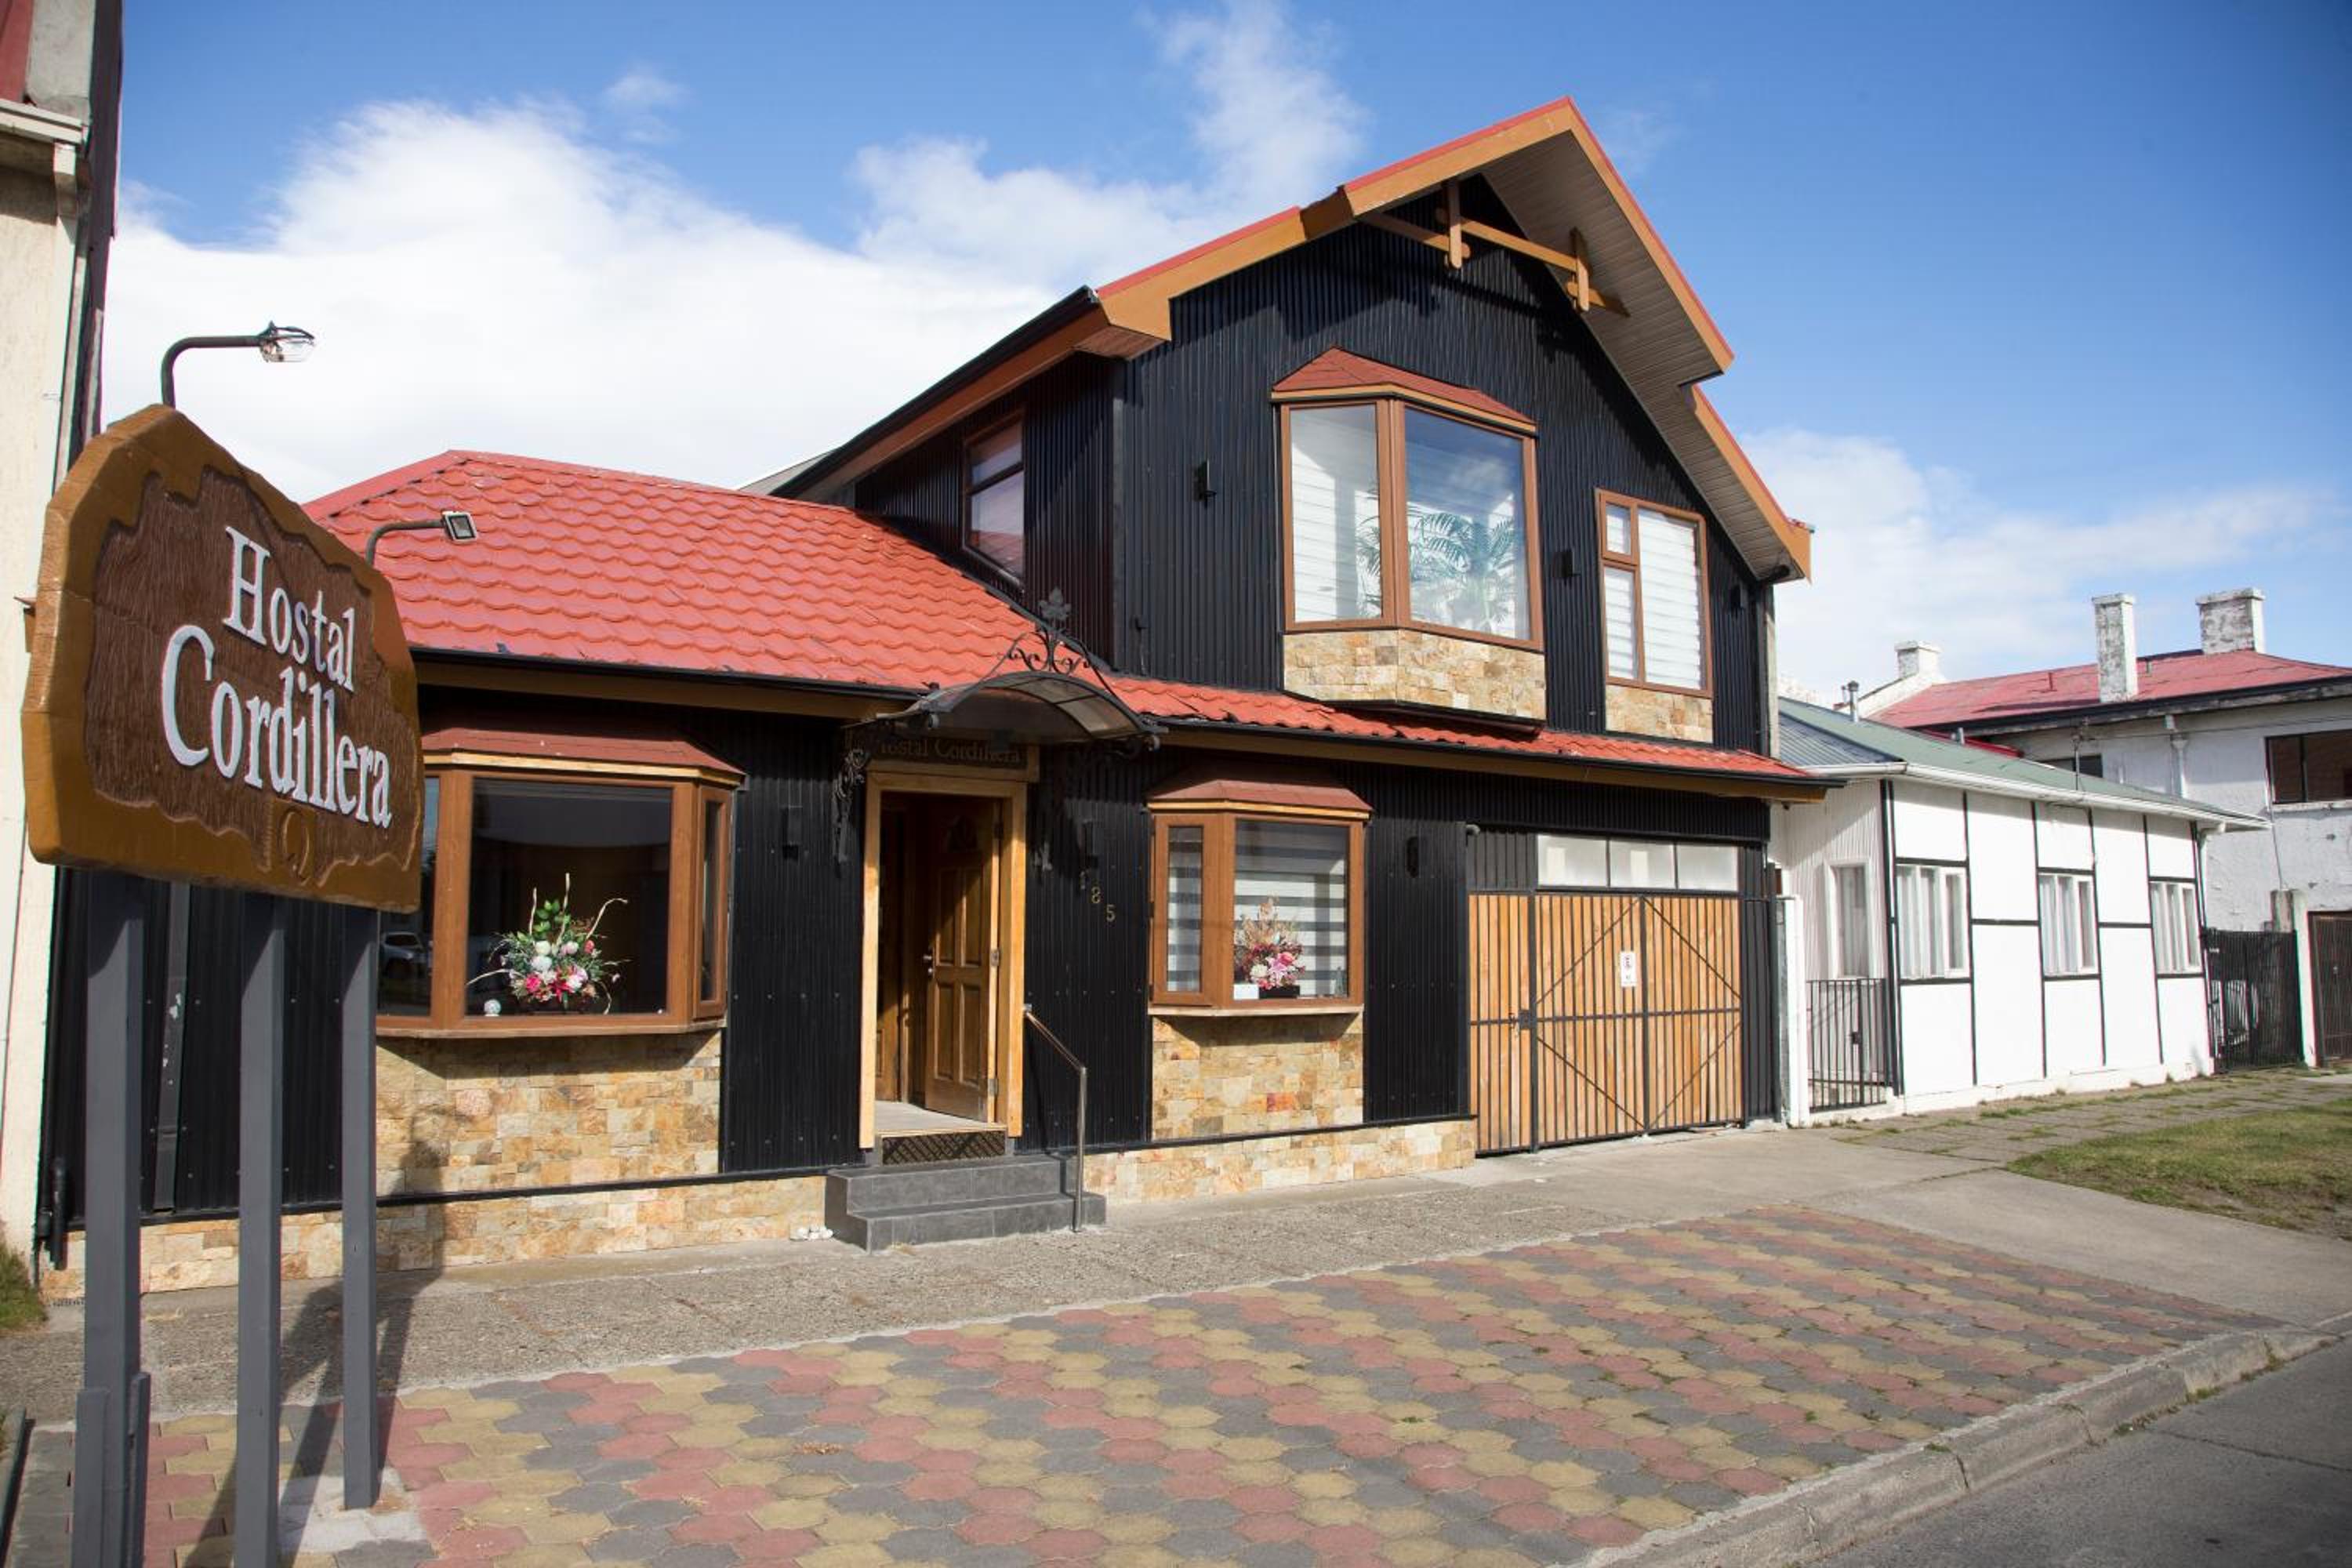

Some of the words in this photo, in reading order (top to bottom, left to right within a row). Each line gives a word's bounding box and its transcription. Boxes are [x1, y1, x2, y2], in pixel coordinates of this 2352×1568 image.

[223, 526, 355, 691] Hostal
[162, 626, 392, 828] Cordillera
[875, 735, 930, 757] ostal
